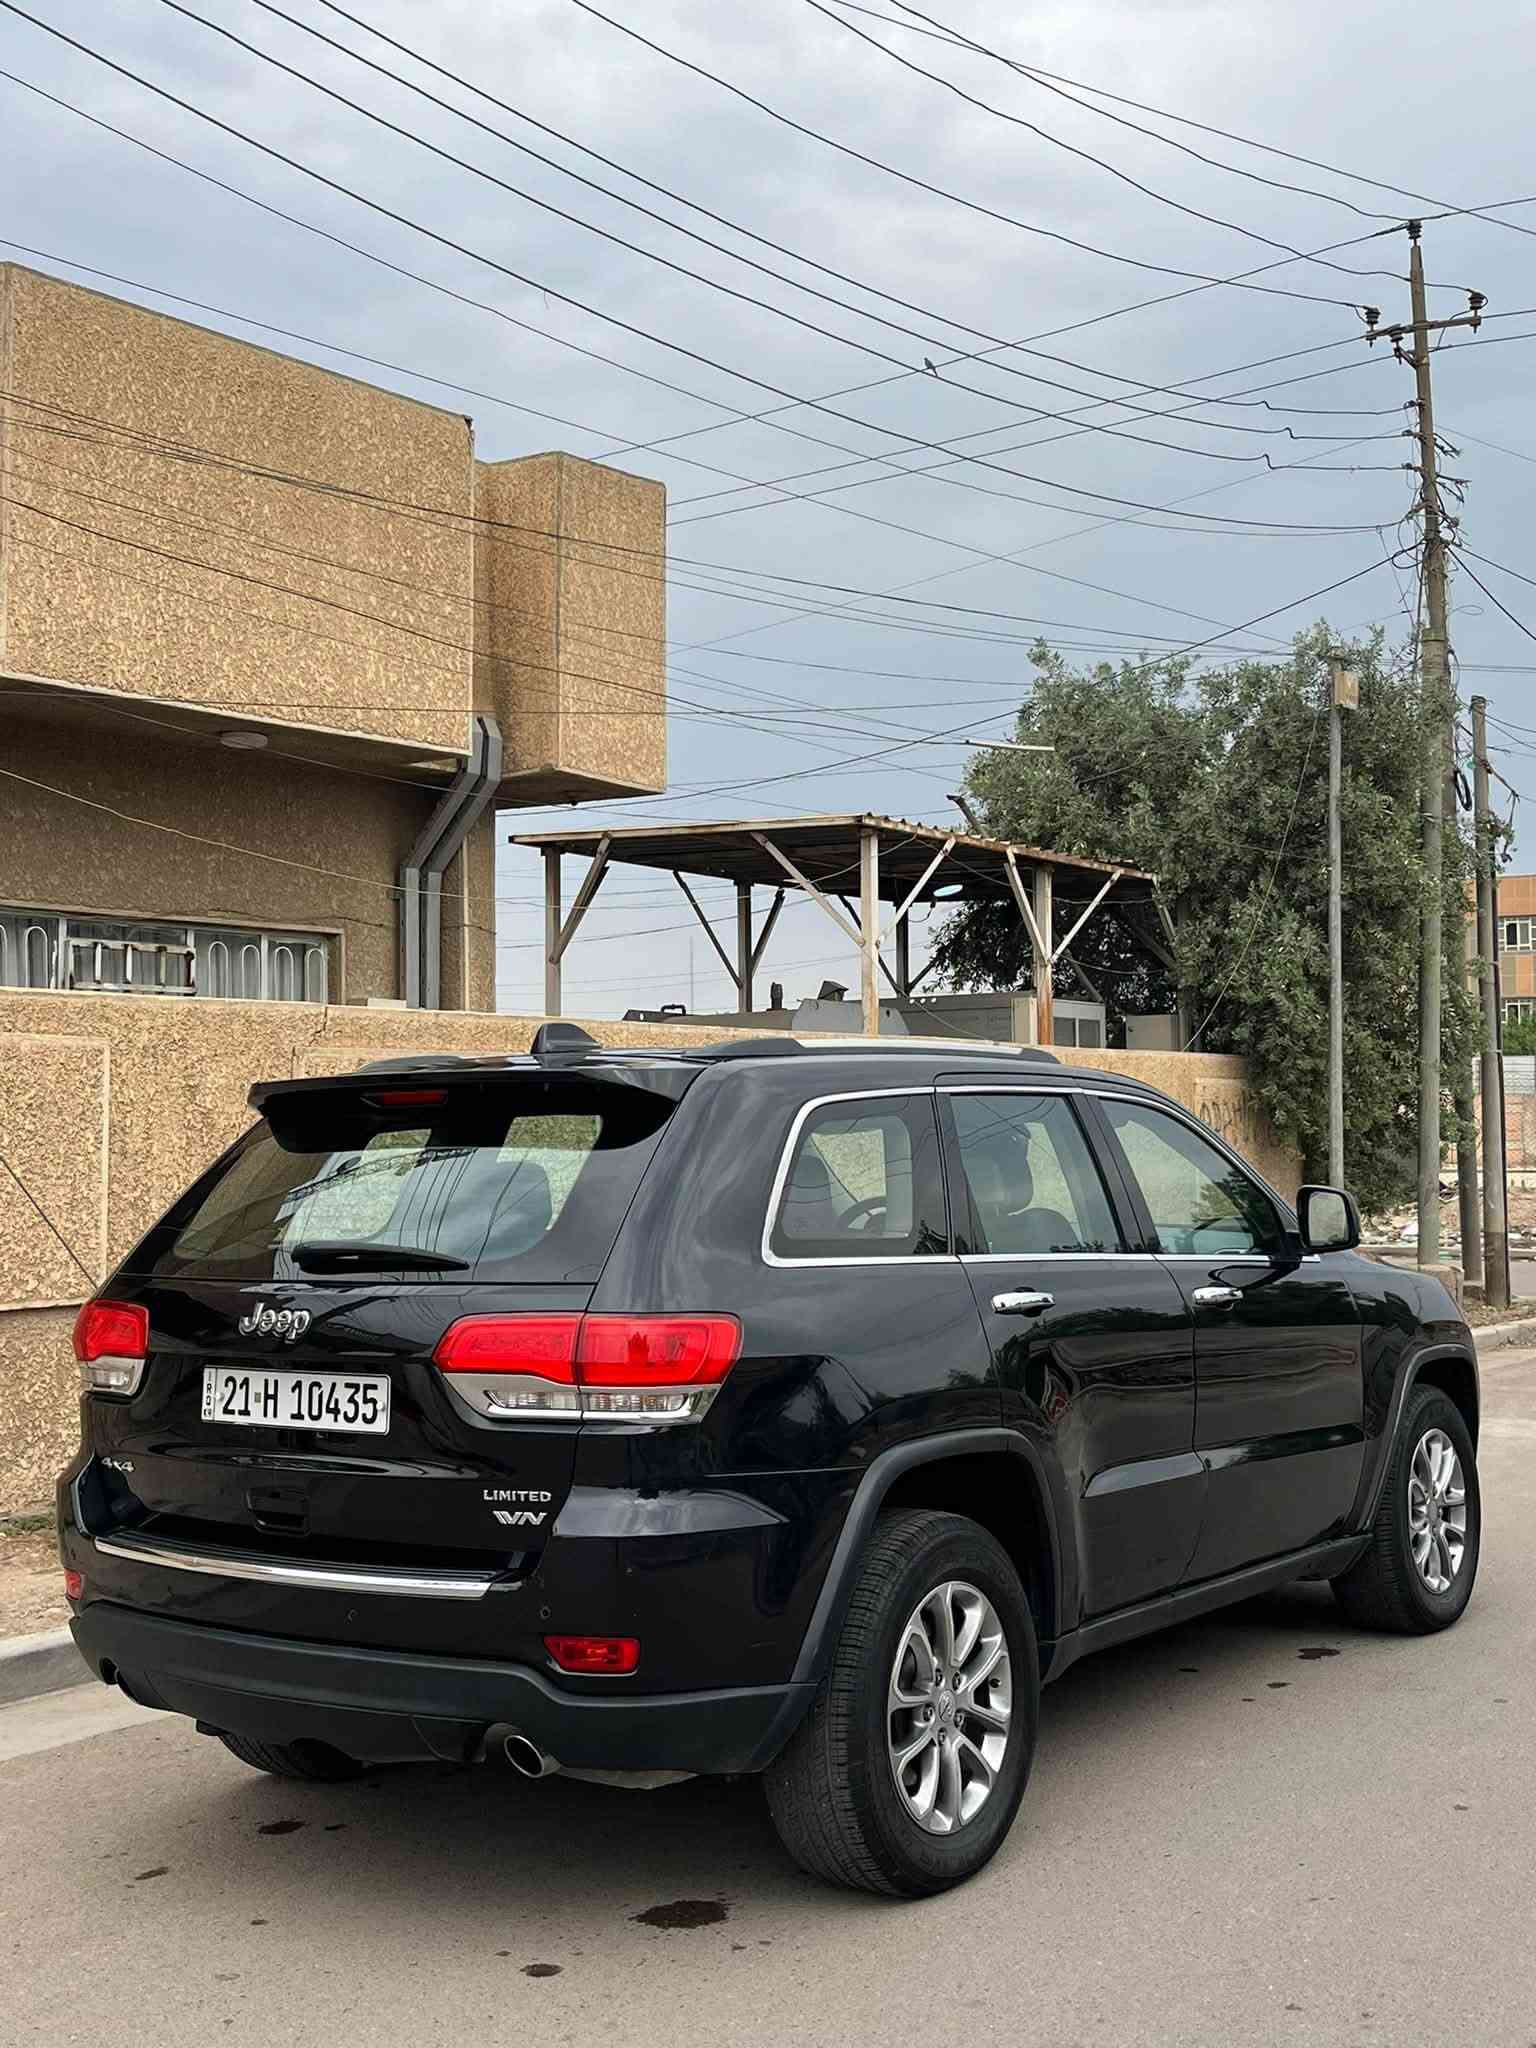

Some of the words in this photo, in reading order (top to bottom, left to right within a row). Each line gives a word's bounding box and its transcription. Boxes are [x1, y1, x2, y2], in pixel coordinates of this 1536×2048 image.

[238, 1302, 312, 1344] Jeep
[222, 1375, 251, 1416] 21
[262, 1378, 279, 1419] H
[290, 1380, 379, 1424] 10435
[483, 1490, 552, 1502] LIMITED
